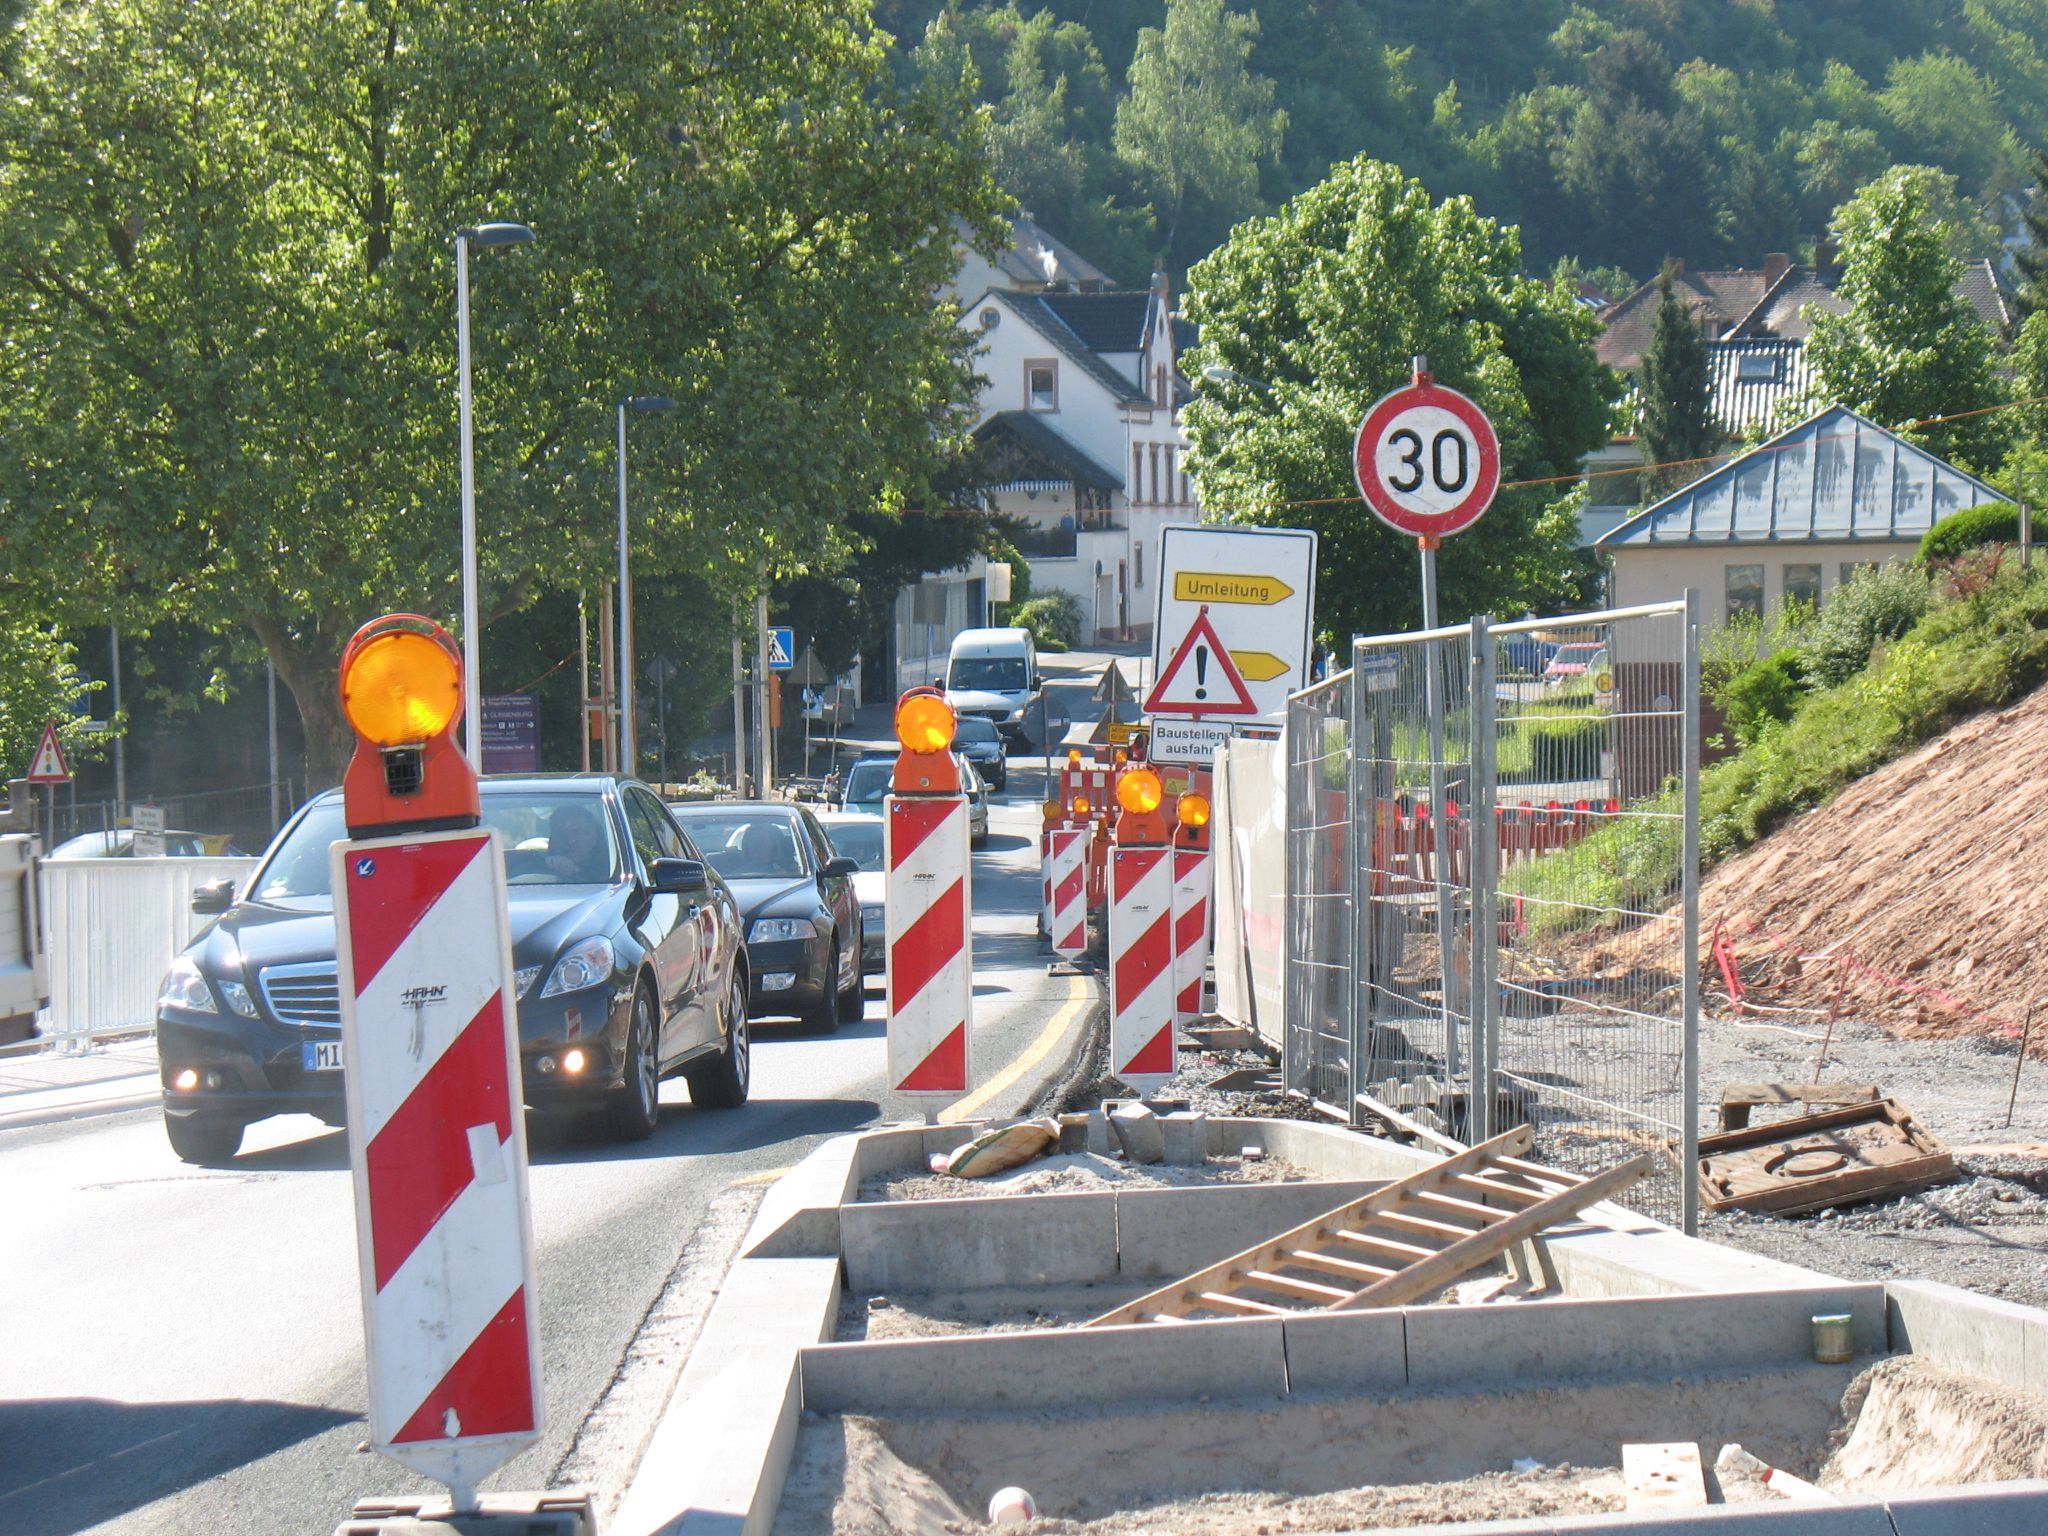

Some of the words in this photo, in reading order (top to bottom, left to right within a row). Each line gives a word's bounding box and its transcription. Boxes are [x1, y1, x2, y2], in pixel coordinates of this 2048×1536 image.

[1388, 428, 1468, 493] 30
[1188, 580, 1269, 601] Umleitung
[1166, 742, 1219, 755] ausfahr
[401, 985, 448, 999] HAHN
[317, 1044, 340, 1067] MI
